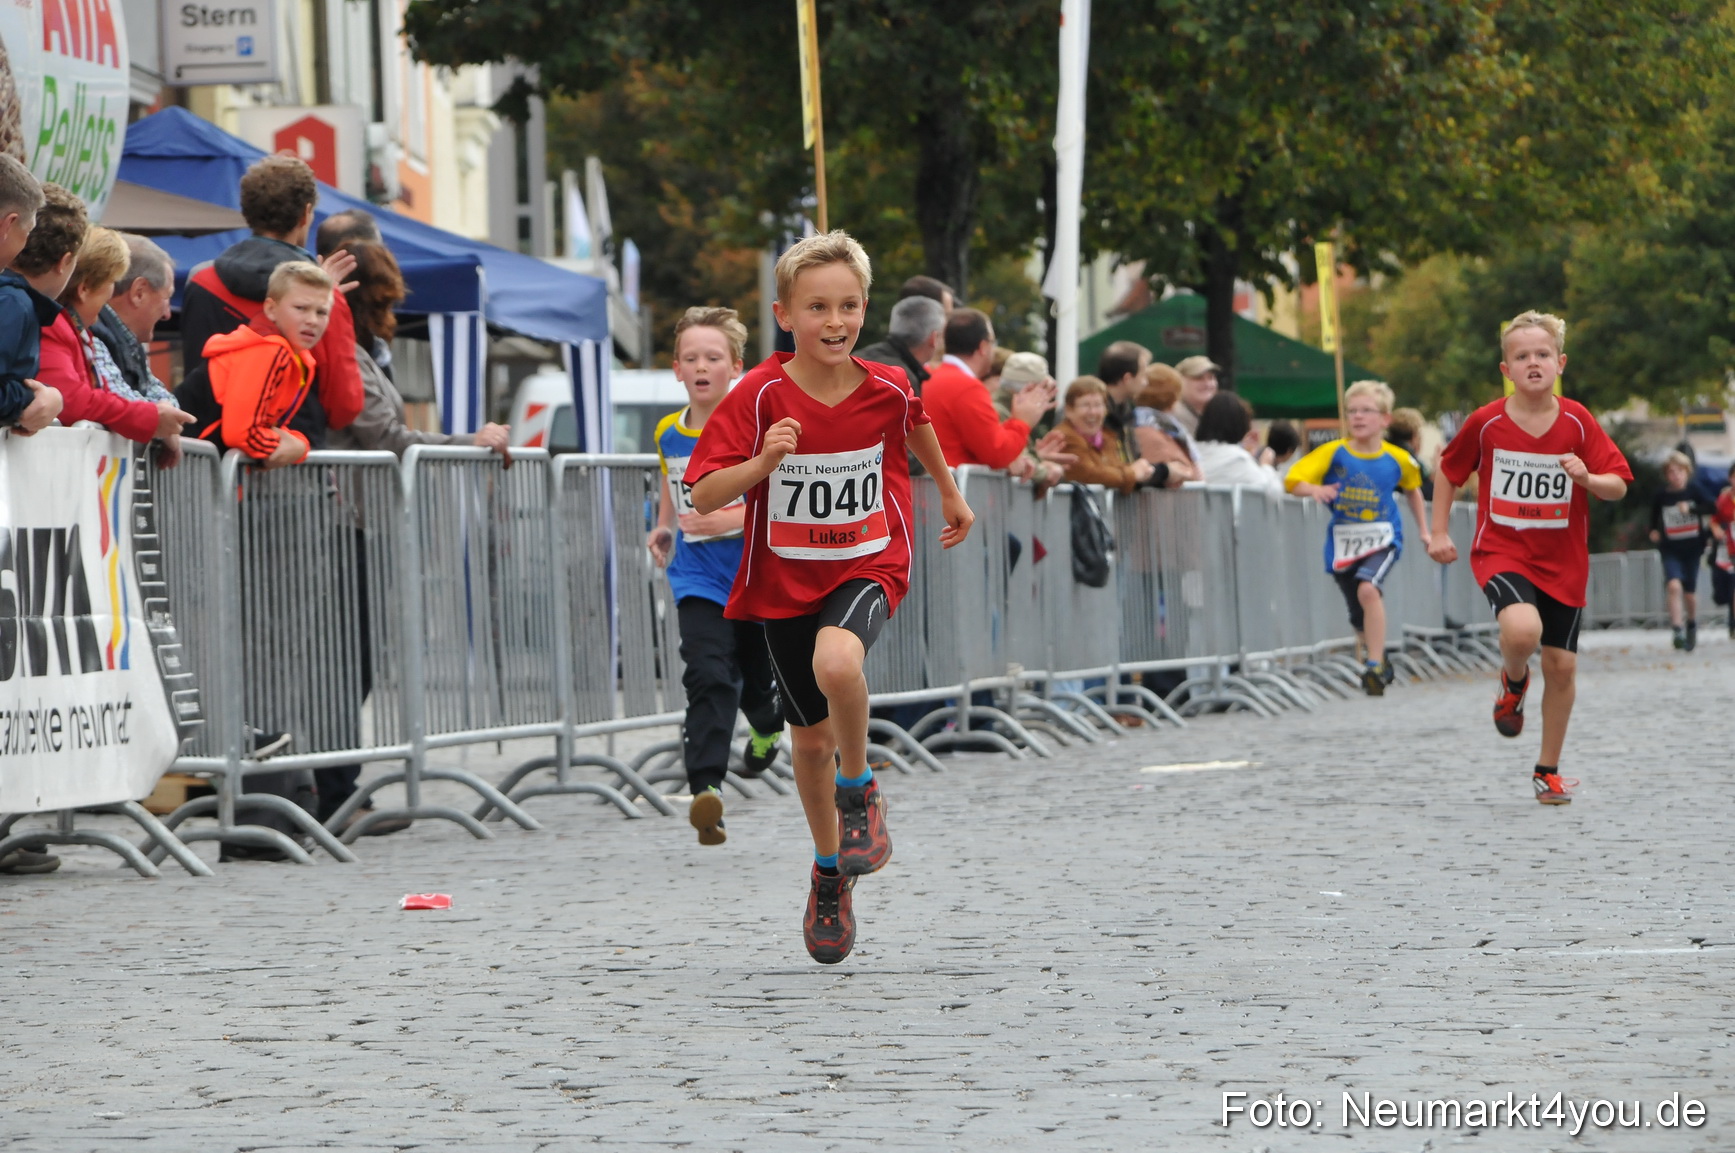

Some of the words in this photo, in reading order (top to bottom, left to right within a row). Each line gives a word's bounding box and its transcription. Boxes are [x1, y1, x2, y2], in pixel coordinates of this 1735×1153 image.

[181, 4, 257, 27] Stern
[777, 462, 813, 475] ARTL
[815, 459, 872, 475] Neumarkt
[1494, 456, 1521, 467] PARTL
[1501, 469, 1567, 499] 7069
[781, 472, 878, 519] 7040
[1518, 506, 1541, 517] Nick
[809, 528, 857, 544] Lukas
